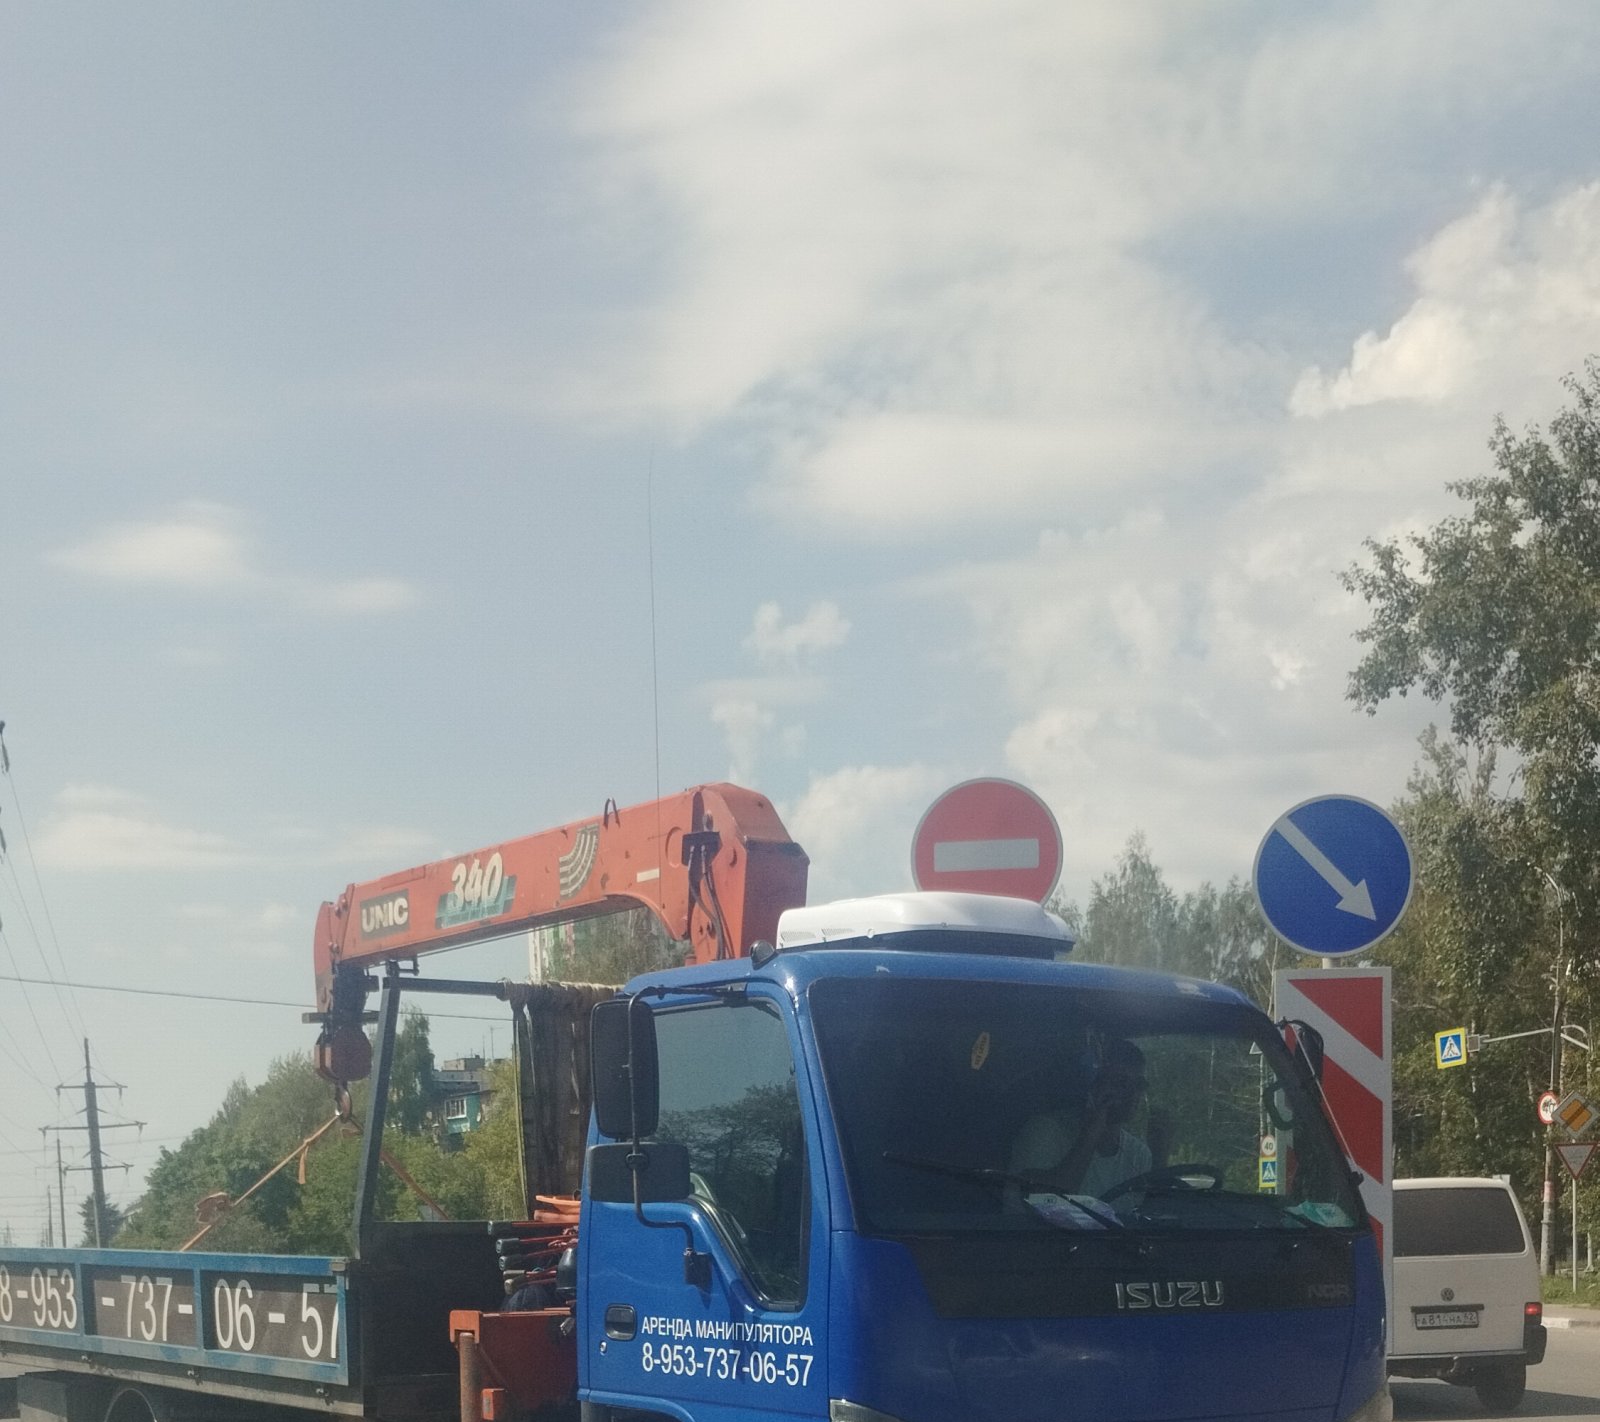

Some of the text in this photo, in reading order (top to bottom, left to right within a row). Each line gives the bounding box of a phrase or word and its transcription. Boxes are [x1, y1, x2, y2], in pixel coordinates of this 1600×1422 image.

[447, 852, 503, 913] 340
[361, 897, 408, 933] UNIC
[1263, 1141, 1274, 1151] 40
[1115, 1281, 1225, 1309] ISUZU
[641, 1316, 814, 1346] АРЕНДА МАНИПУЛЯТОРА
[642, 1342, 814, 1387] 8-953-737-06-57
